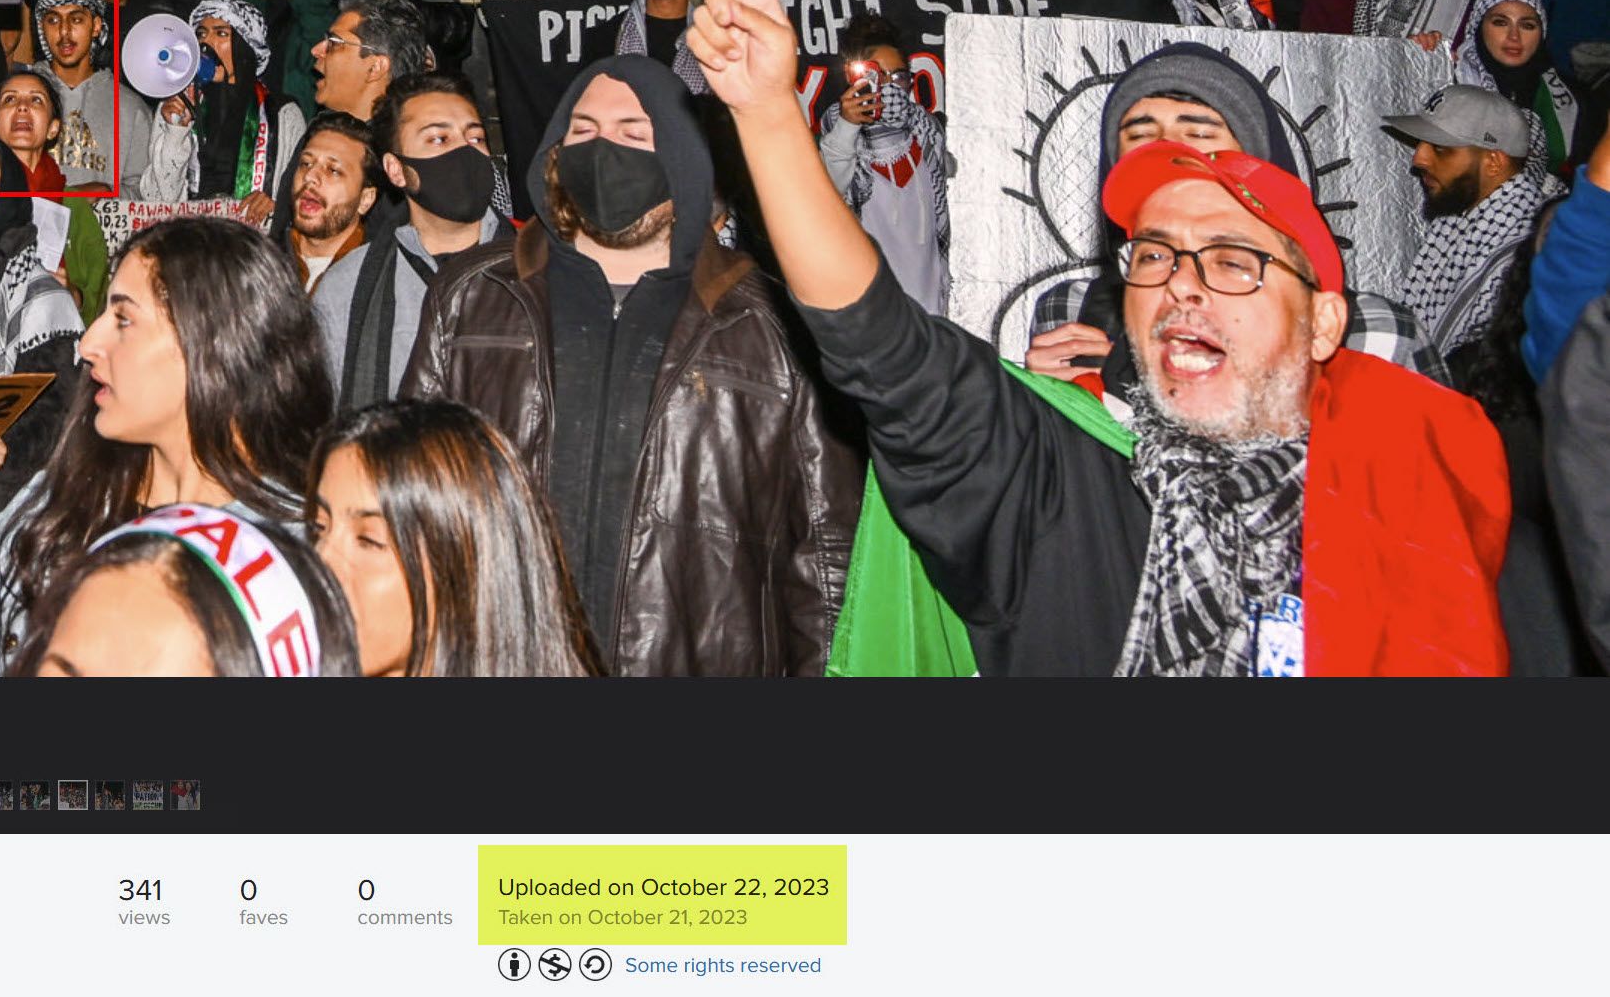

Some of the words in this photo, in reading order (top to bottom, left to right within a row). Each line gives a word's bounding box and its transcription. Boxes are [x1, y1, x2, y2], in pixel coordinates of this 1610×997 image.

[134, 509, 314, 677] ALE
[118, 878, 161, 902] 341
[240, 878, 258, 902] 0
[358, 878, 376, 902] 0
[499, 878, 601, 901] Uploaded
[607, 882, 634, 896] on
[641, 878, 728, 896] October
[734, 878, 767, 899] 22,
[774, 878, 829, 896] 2023
[118, 909, 171, 925] views
[239, 909, 288, 925] faves
[357, 910, 453, 925] comments
[498, 909, 553, 925] Taken
[558, 913, 582, 925] on
[588, 909, 664, 925] October
[669, 909, 693, 928] 21,
[698, 909, 748, 925] 2023
[625, 957, 679, 973] Some
[684, 957, 735, 977] rights
[740, 957, 821, 973] reserved
